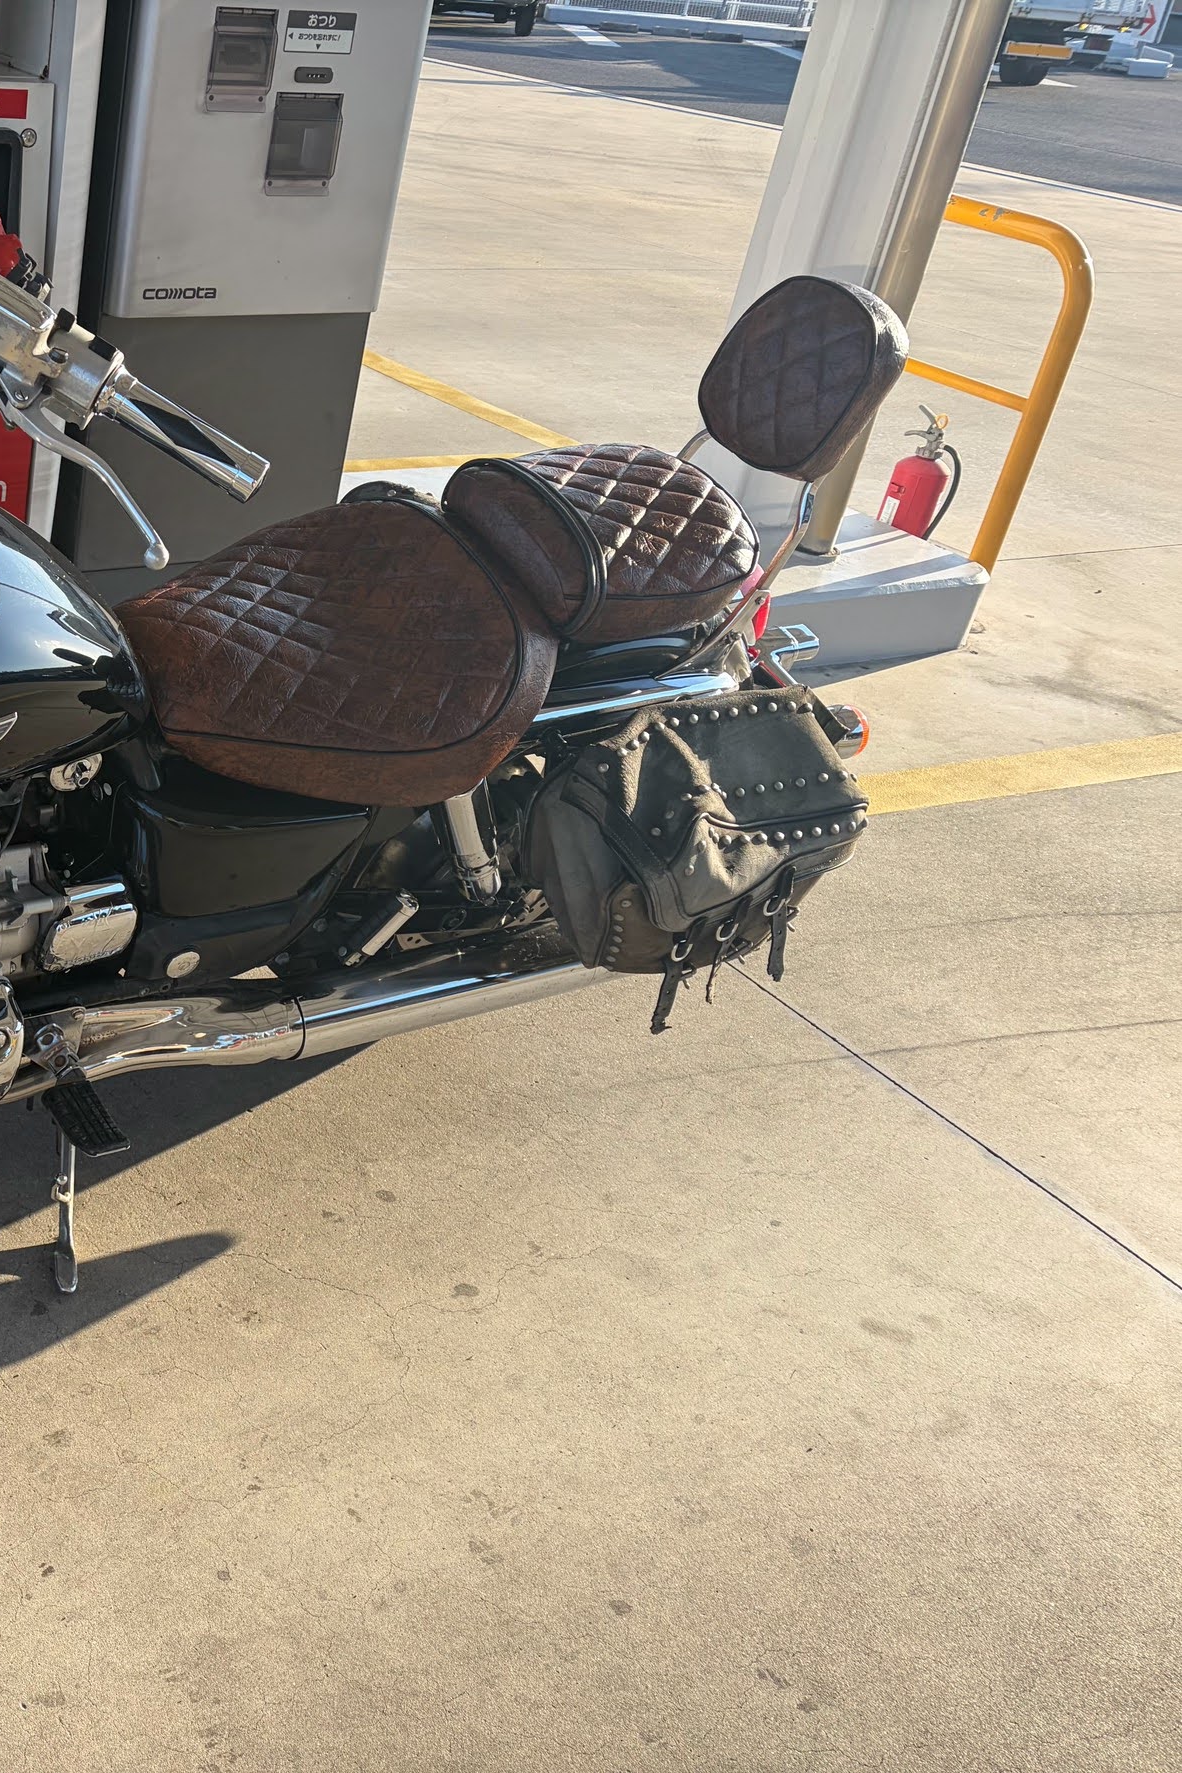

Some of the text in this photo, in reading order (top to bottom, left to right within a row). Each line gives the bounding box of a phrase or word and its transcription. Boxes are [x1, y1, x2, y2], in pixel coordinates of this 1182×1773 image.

[307, 14, 337, 28] おつり
[143, 286, 217, 300] comota
